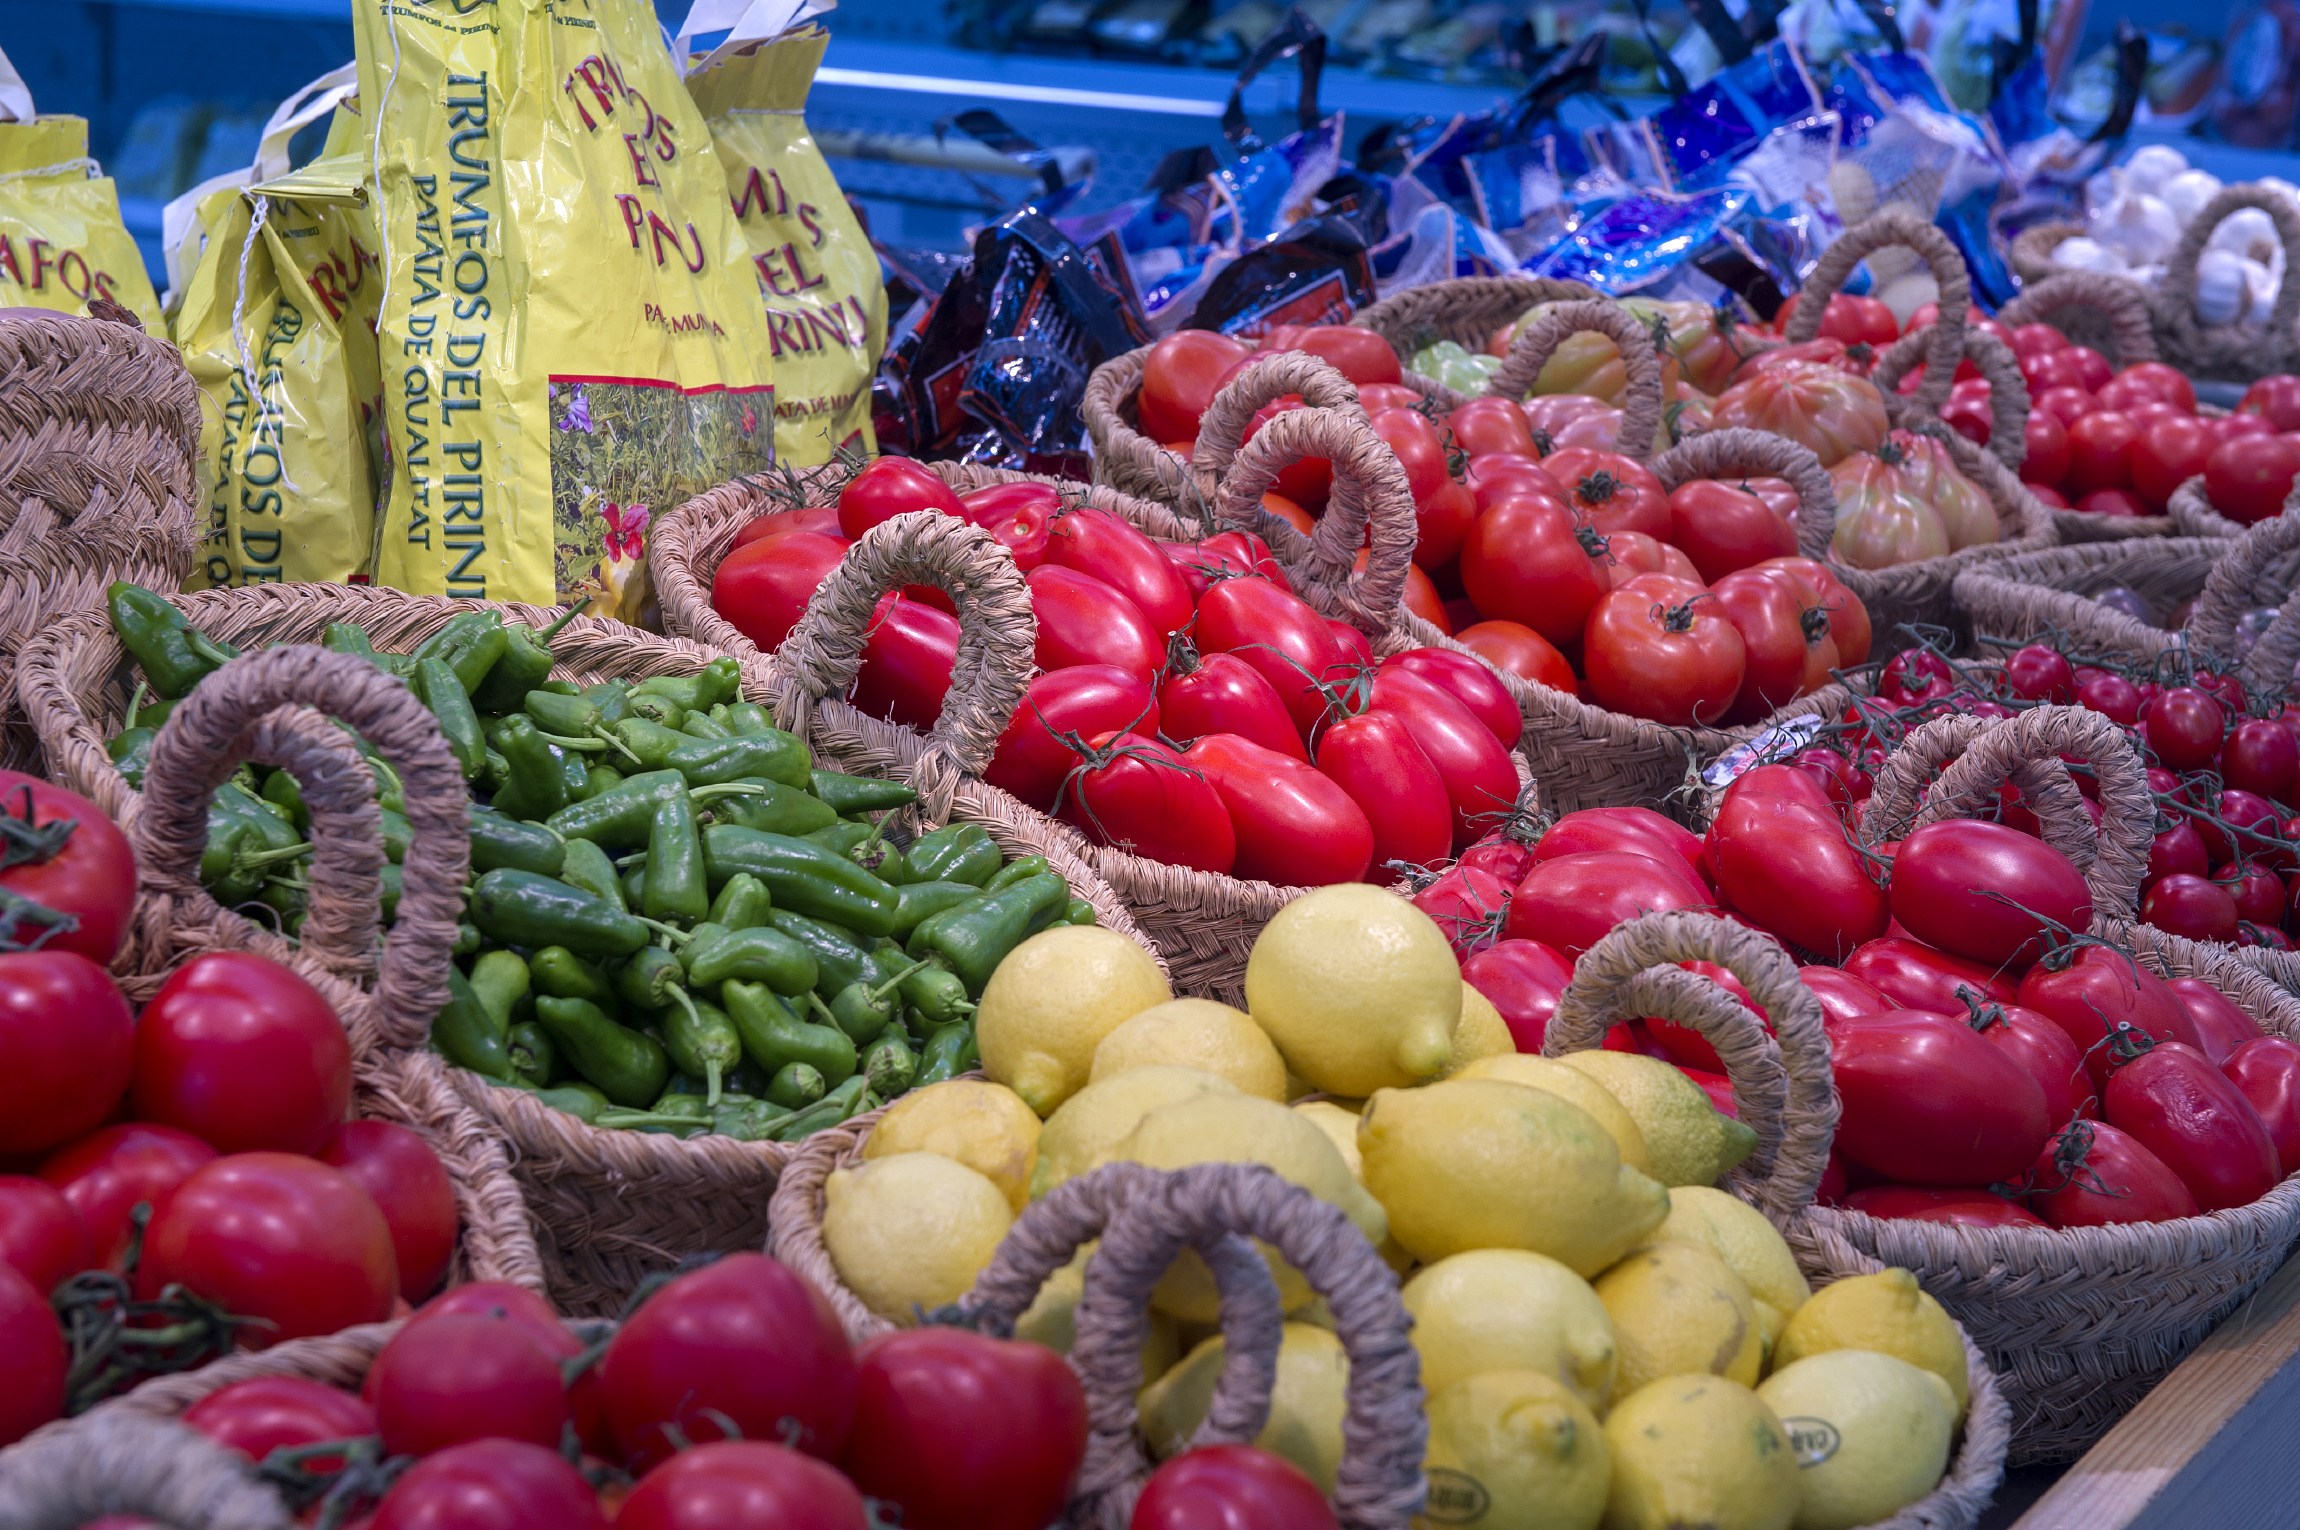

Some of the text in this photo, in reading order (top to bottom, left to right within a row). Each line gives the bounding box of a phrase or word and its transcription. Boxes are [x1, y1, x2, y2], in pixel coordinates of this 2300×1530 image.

[402, 174, 444, 551] PATATA DE QUALITAT
[441, 70, 491, 600] TRUMFOS DEL PIRIN
